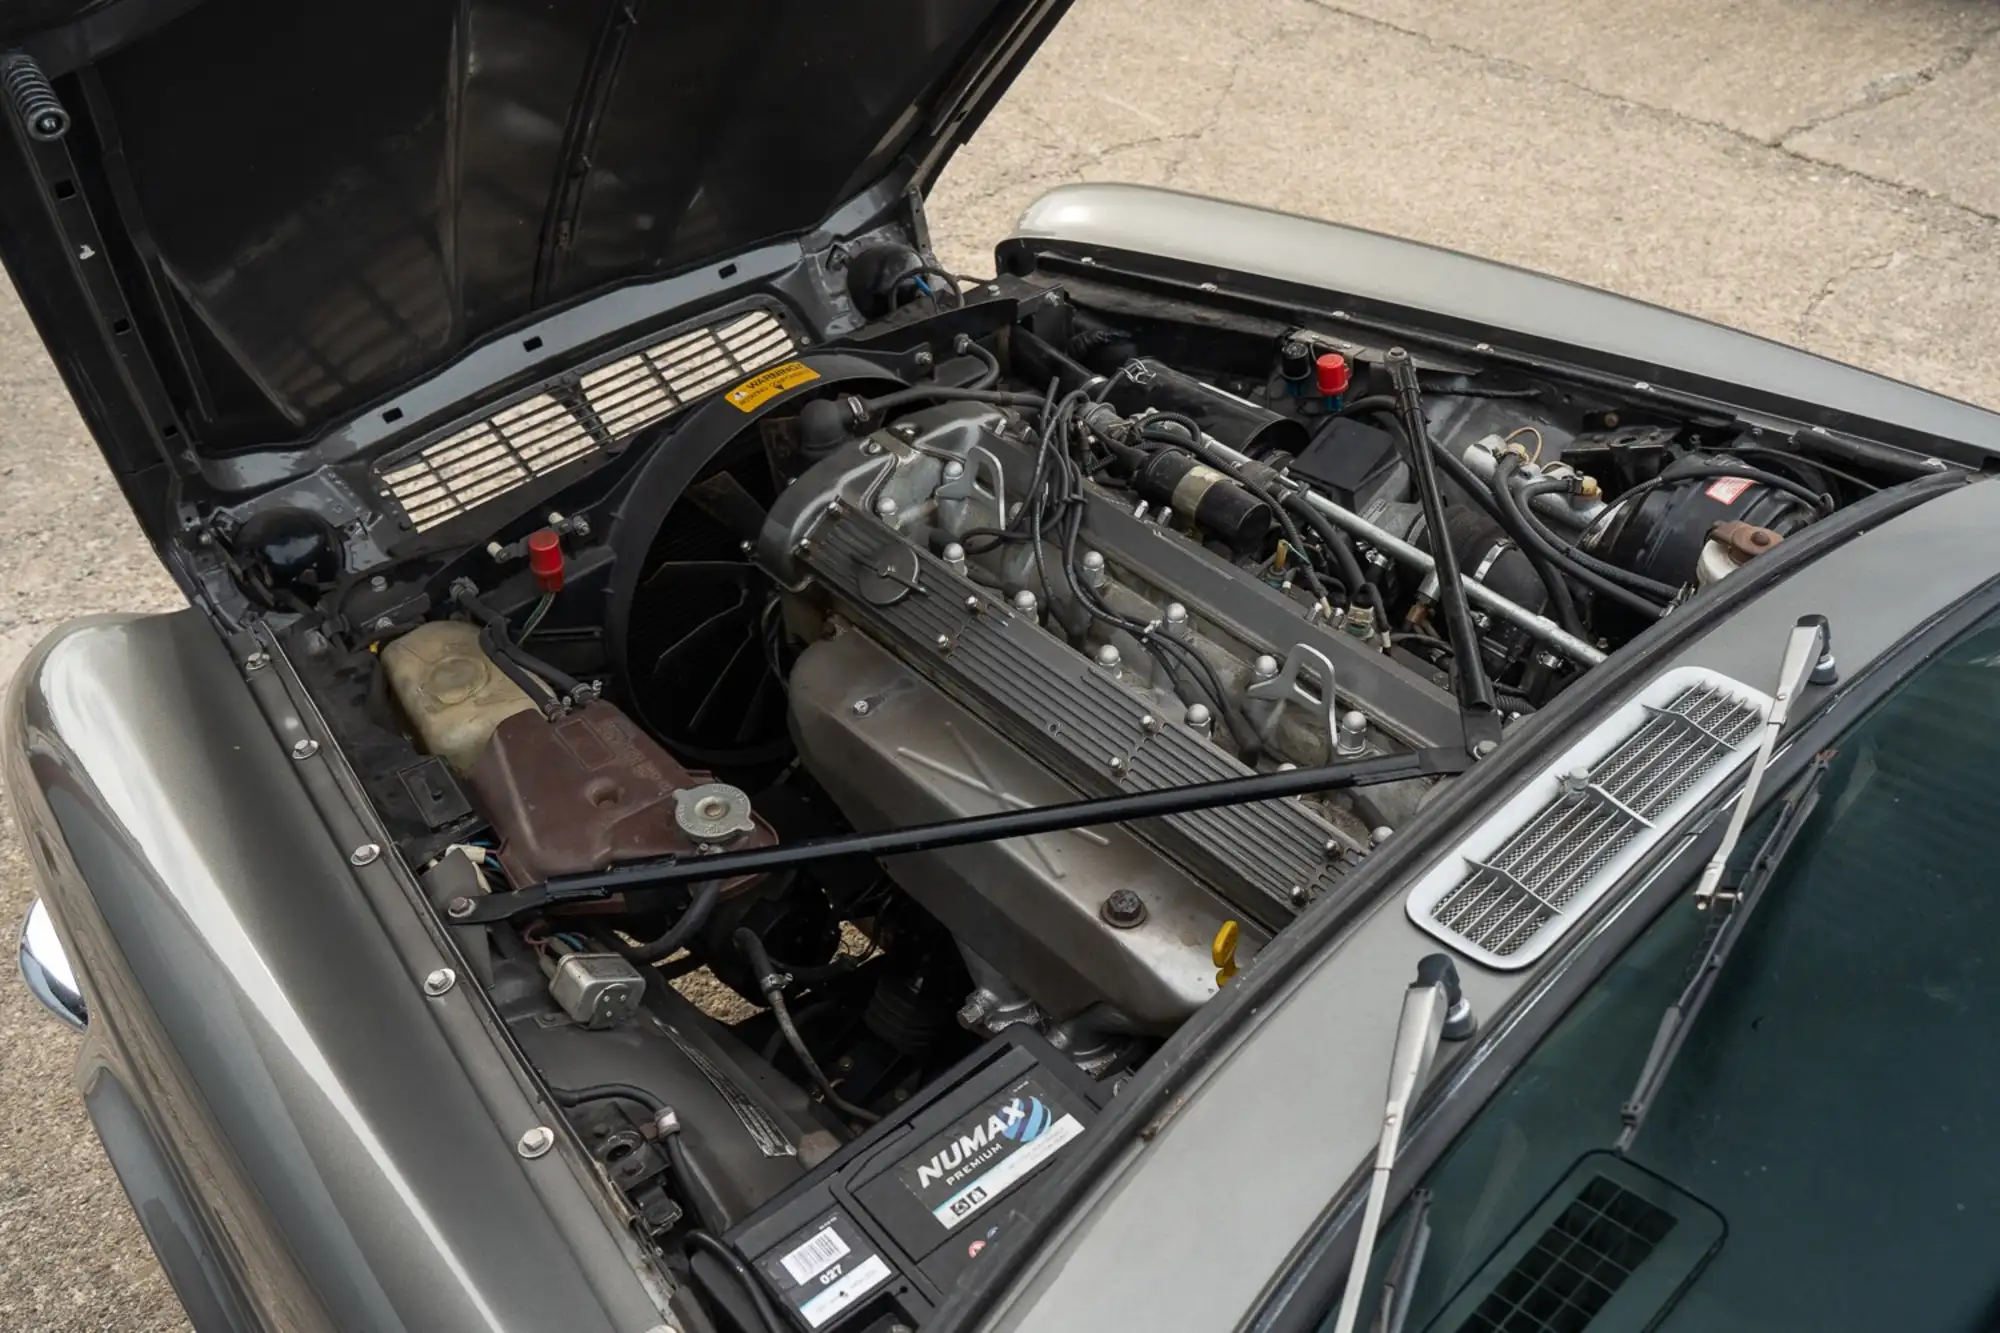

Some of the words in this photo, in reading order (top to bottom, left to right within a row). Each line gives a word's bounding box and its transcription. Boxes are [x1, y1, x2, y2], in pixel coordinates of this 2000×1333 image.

[917, 1098, 1026, 1188] NUMAX
[945, 1143, 1003, 1186] PREMIUM
[820, 1263, 843, 1285] 027
